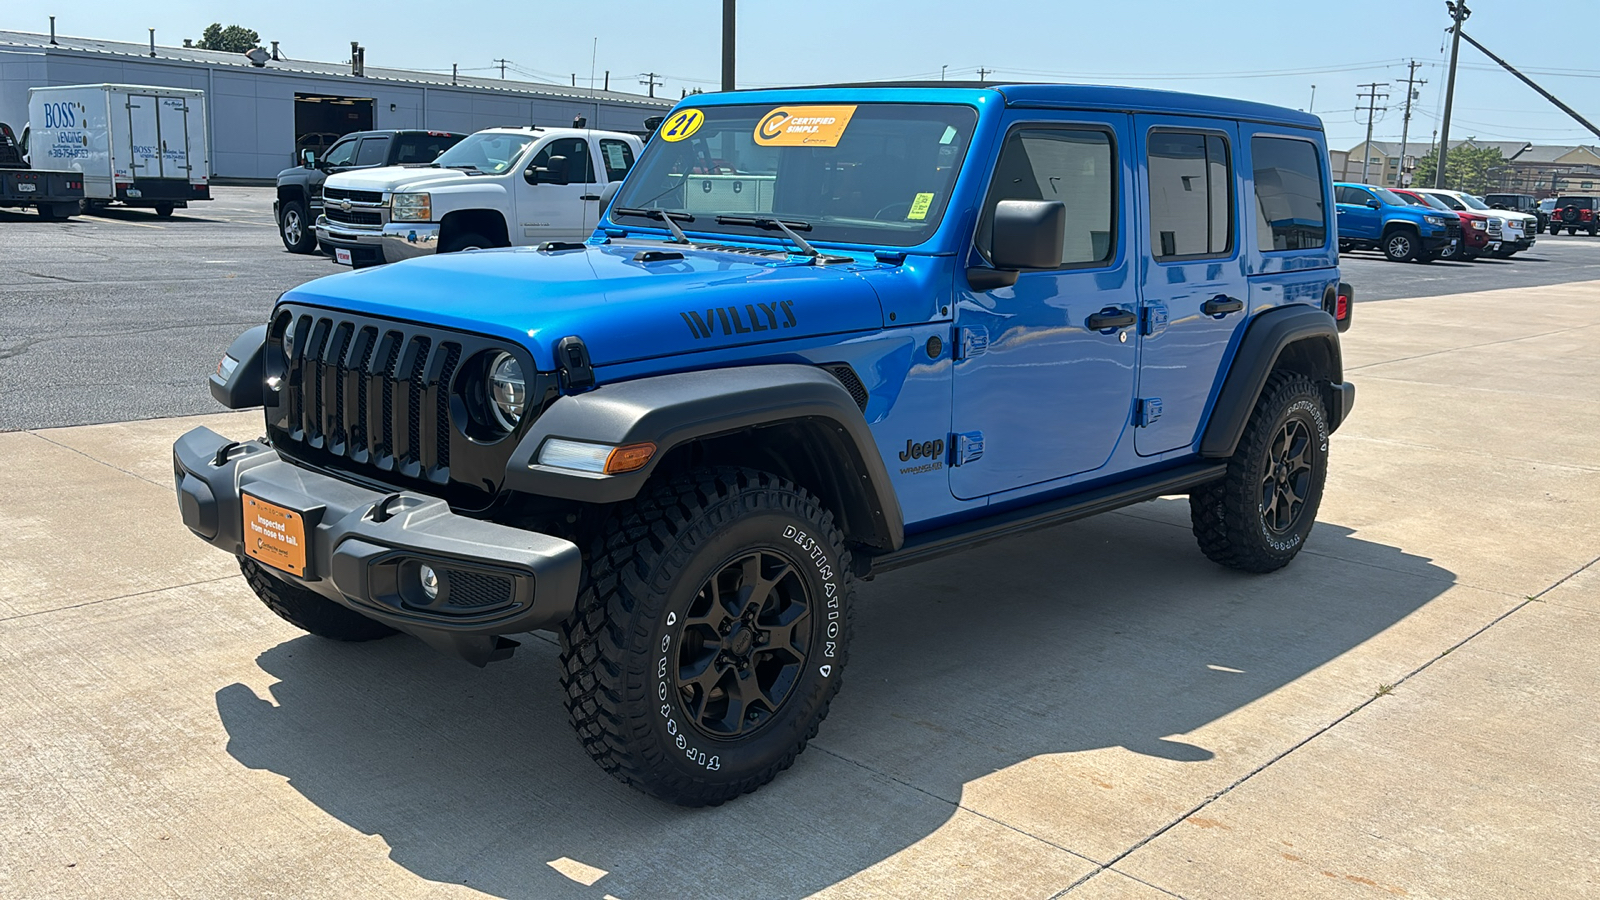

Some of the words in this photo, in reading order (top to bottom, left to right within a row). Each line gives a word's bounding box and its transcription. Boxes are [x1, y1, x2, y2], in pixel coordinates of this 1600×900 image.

[44, 102, 75, 128] BOSS
[667, 113, 698, 136] 21
[790, 117, 836, 125] CERTIFIED
[56, 131, 82, 143] VENDING
[786, 125, 819, 133] SIMPLE.
[133, 145, 152, 153] BOSS
[679, 300, 797, 339] WILLYS
[899, 439, 944, 462] Jeep
[899, 461, 943, 475] WRANGLER
[257, 514, 285, 532] Inspected
[250, 521, 262, 533] from
[263, 527, 277, 539] nose
[278, 532, 285, 542] to
[286, 534, 298, 546] tail.
[783, 525, 839, 658] DESTINATION
